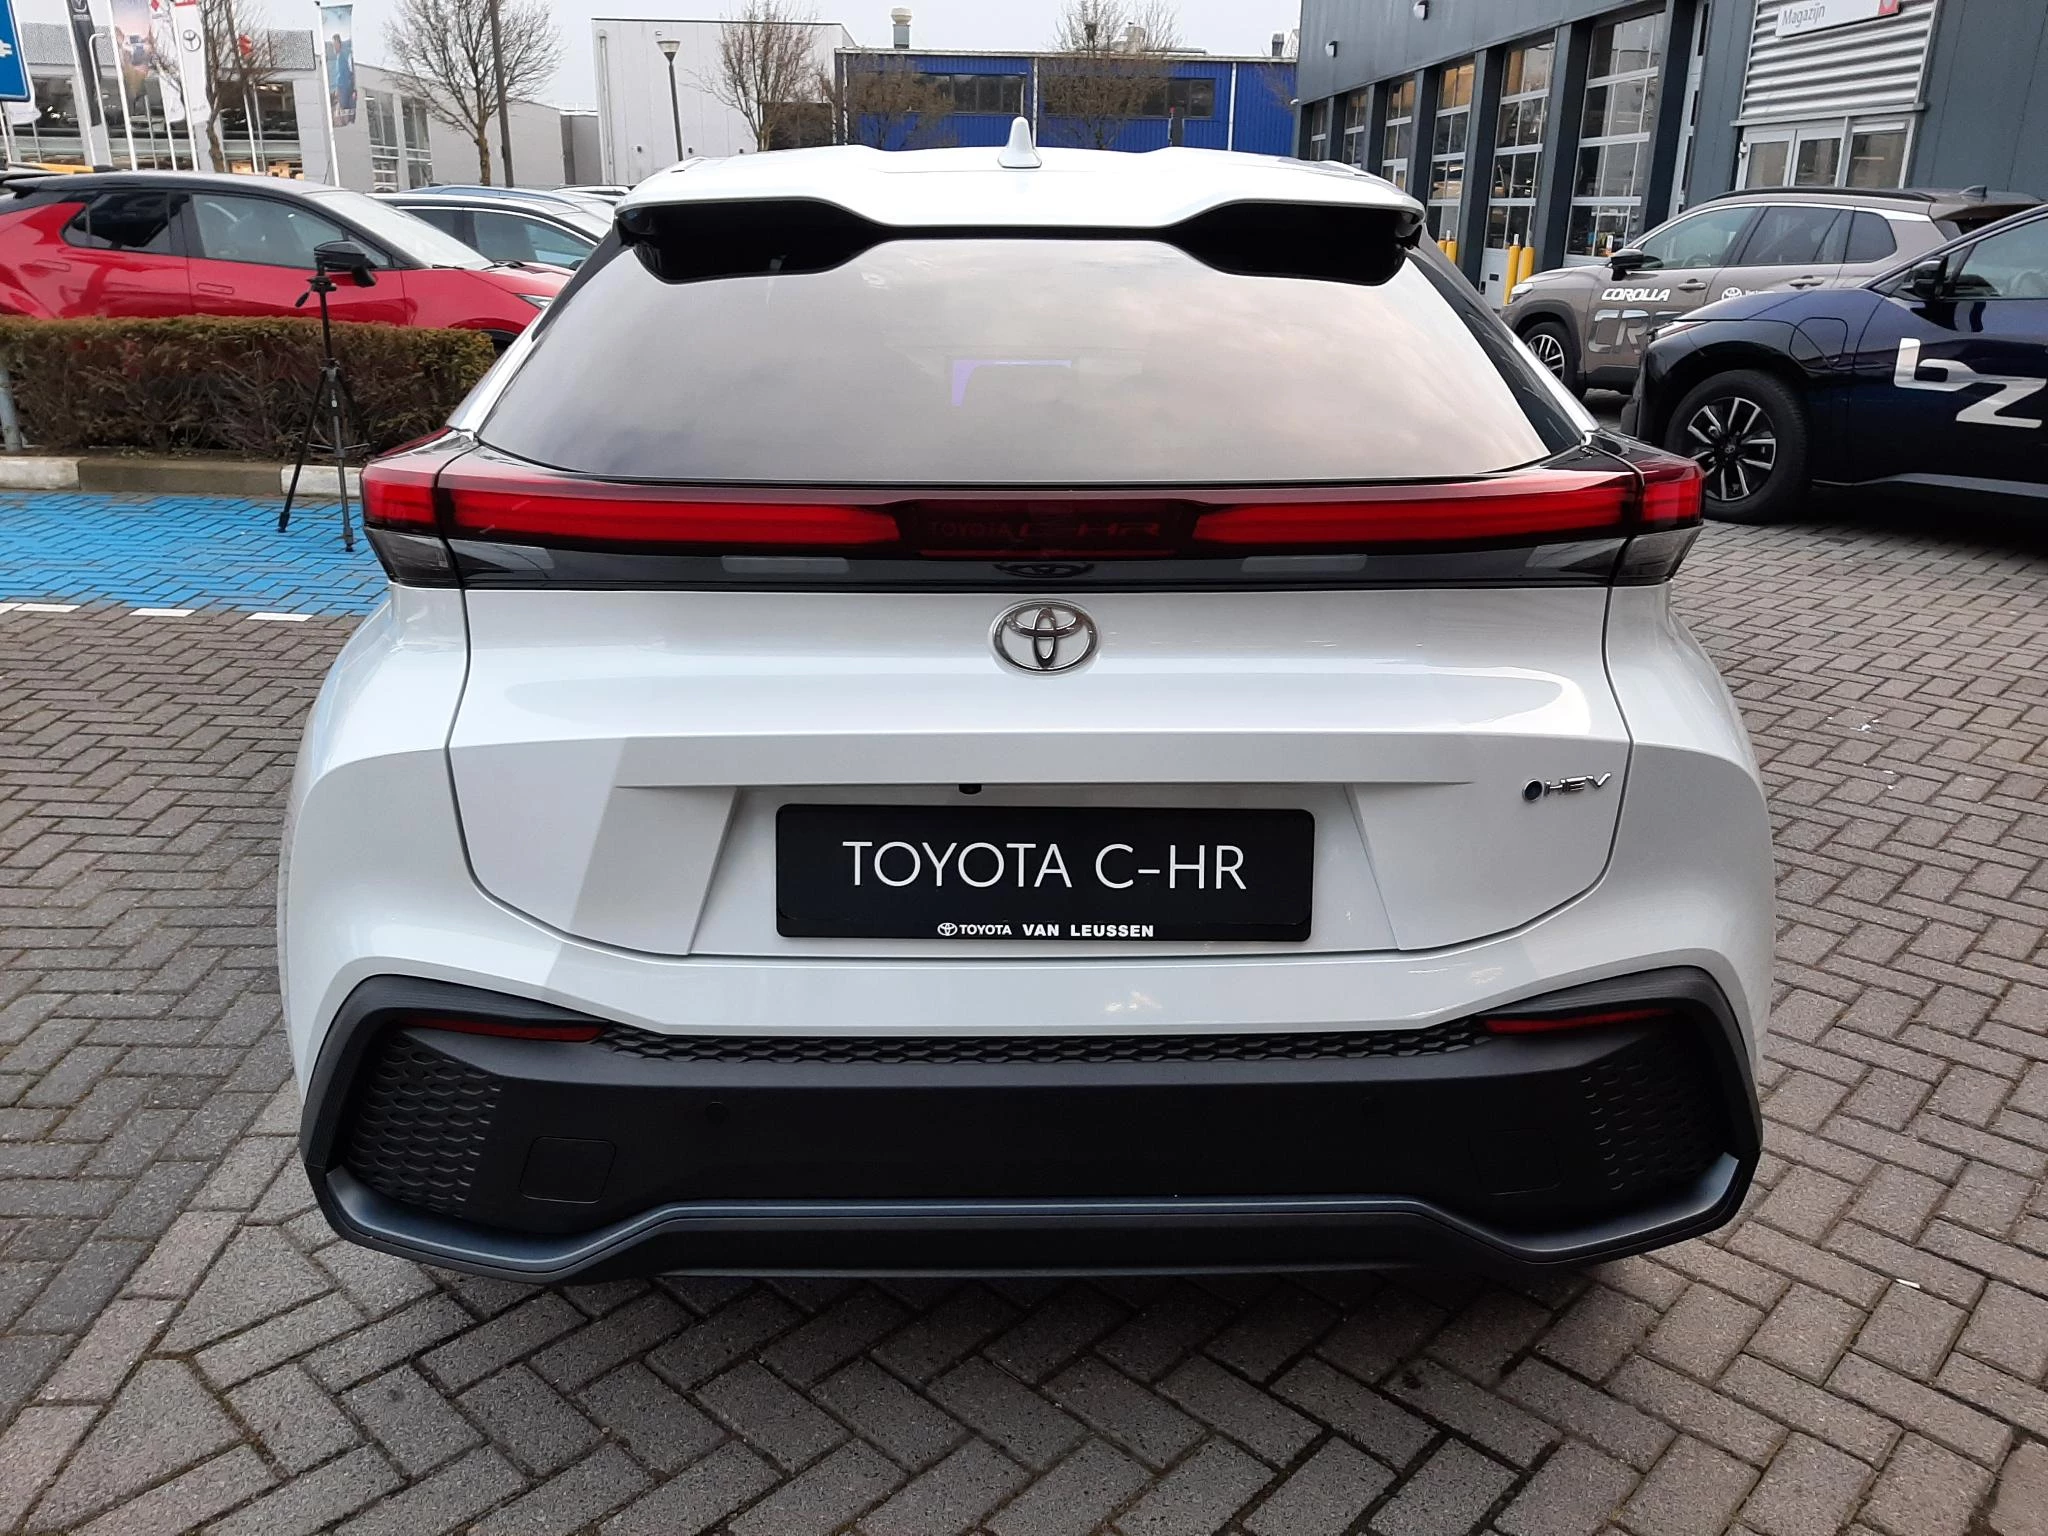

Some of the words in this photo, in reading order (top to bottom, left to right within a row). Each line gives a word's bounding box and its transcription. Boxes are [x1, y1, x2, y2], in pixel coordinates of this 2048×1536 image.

[1781, 3, 1826, 28] Magazijn
[1601, 288, 1671, 302] COROLLA
[928, 521, 1013, 538] TOYOTA
[1543, 772, 1612, 797] HEV
[842, 841, 1073, 888] TOYOTA
[1095, 843, 1247, 890] C-HR
[959, 924, 1012, 936] TOYOTA
[1022, 924, 1060, 937] VAN
[1070, 924, 1154, 938] LEUSSEN
